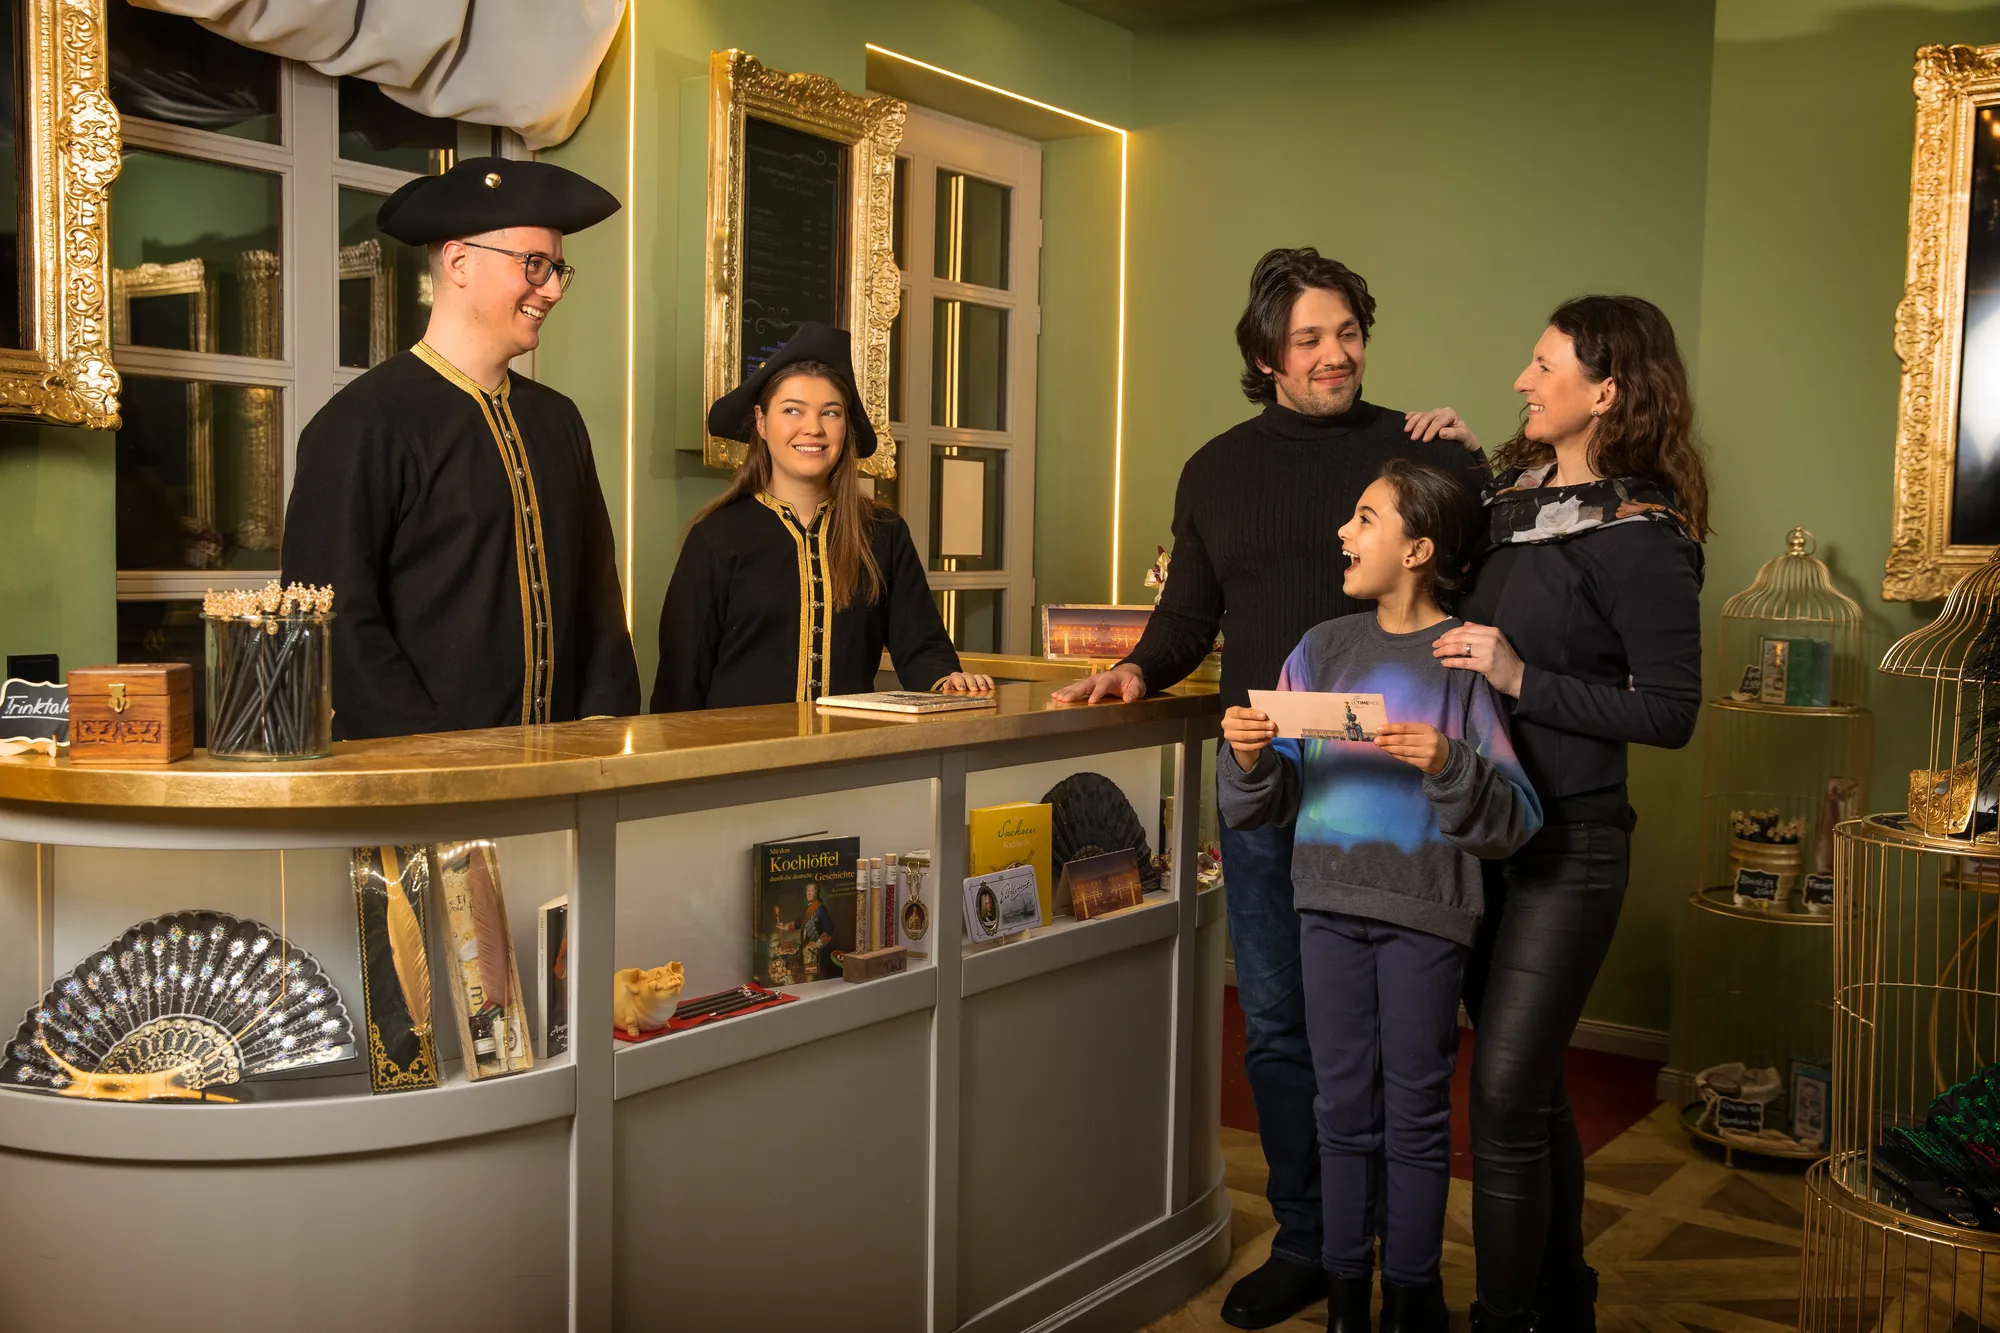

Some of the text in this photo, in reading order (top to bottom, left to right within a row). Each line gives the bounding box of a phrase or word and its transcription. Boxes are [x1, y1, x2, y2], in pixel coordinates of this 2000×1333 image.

[998, 819, 1036, 838] Sachsen
[770, 851, 839, 873] Kochlöffel
[814, 870, 855, 882] Geschichte
